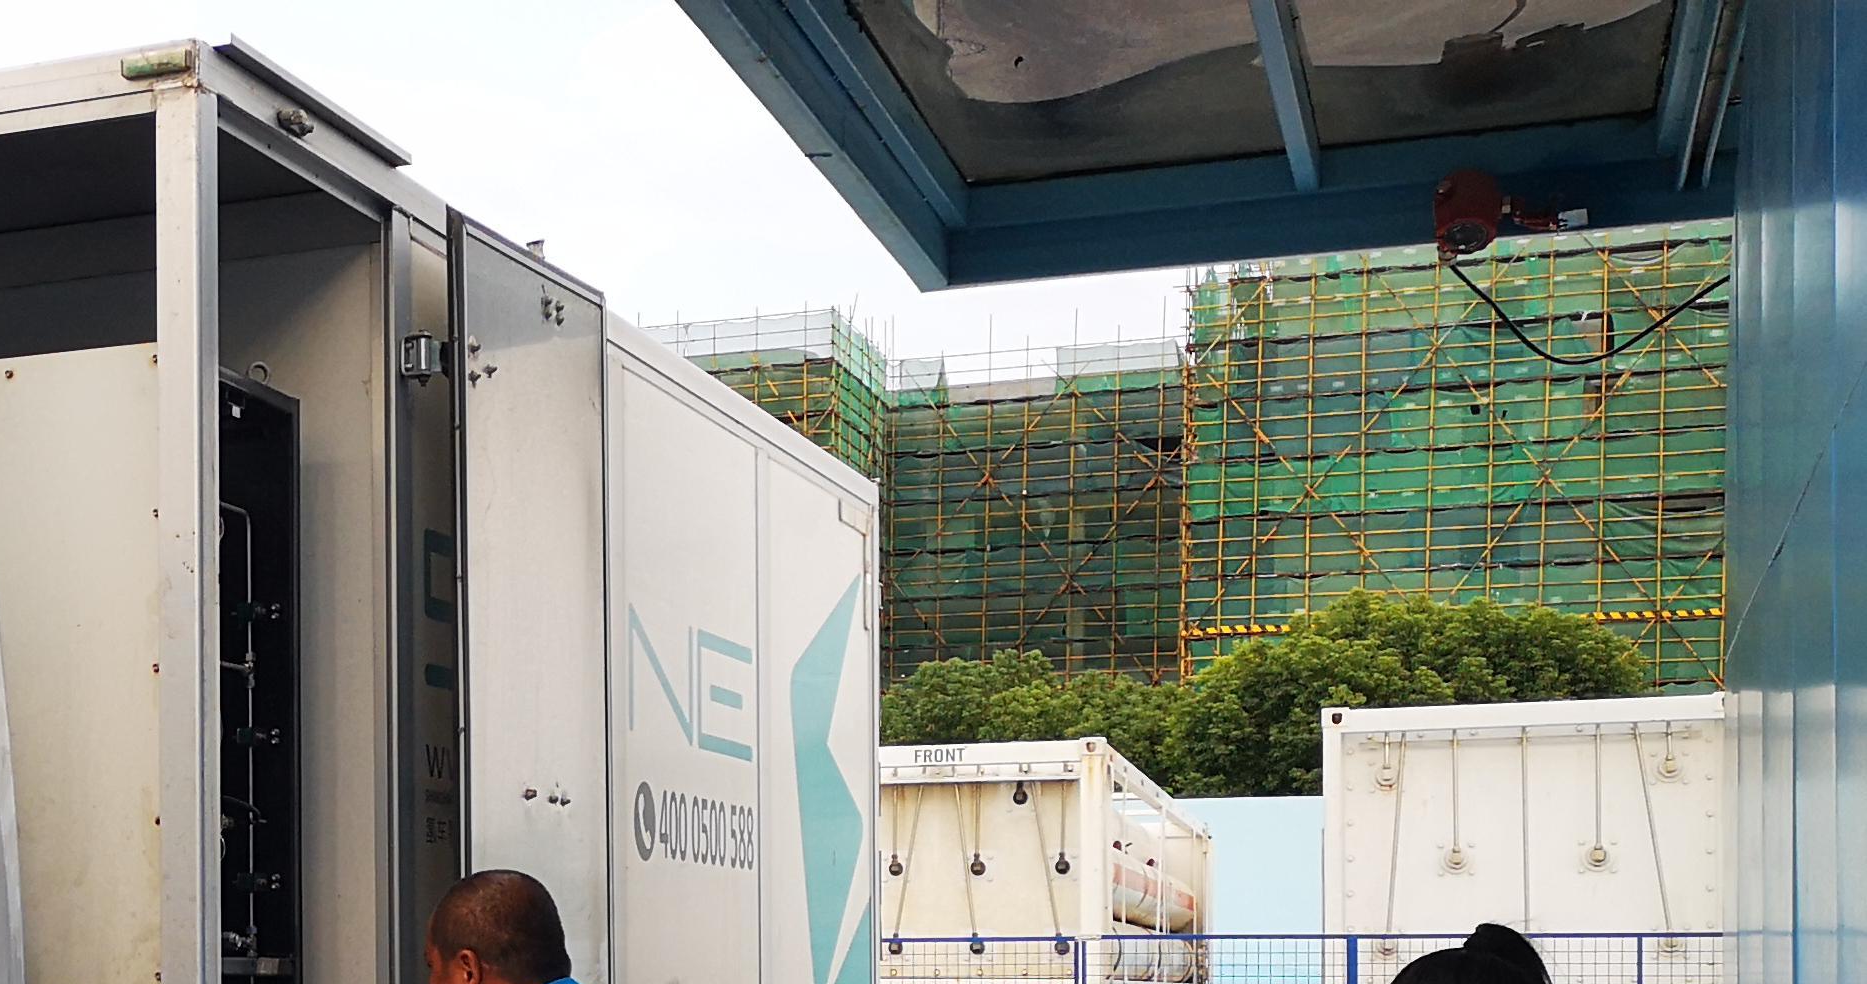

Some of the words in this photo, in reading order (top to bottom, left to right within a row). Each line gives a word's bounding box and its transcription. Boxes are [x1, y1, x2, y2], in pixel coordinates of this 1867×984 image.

[914, 747, 967, 764] FRONT
[659, 789, 687, 862] 400
[692, 795, 726, 867] 0500
[730, 804, 754, 871] 588
